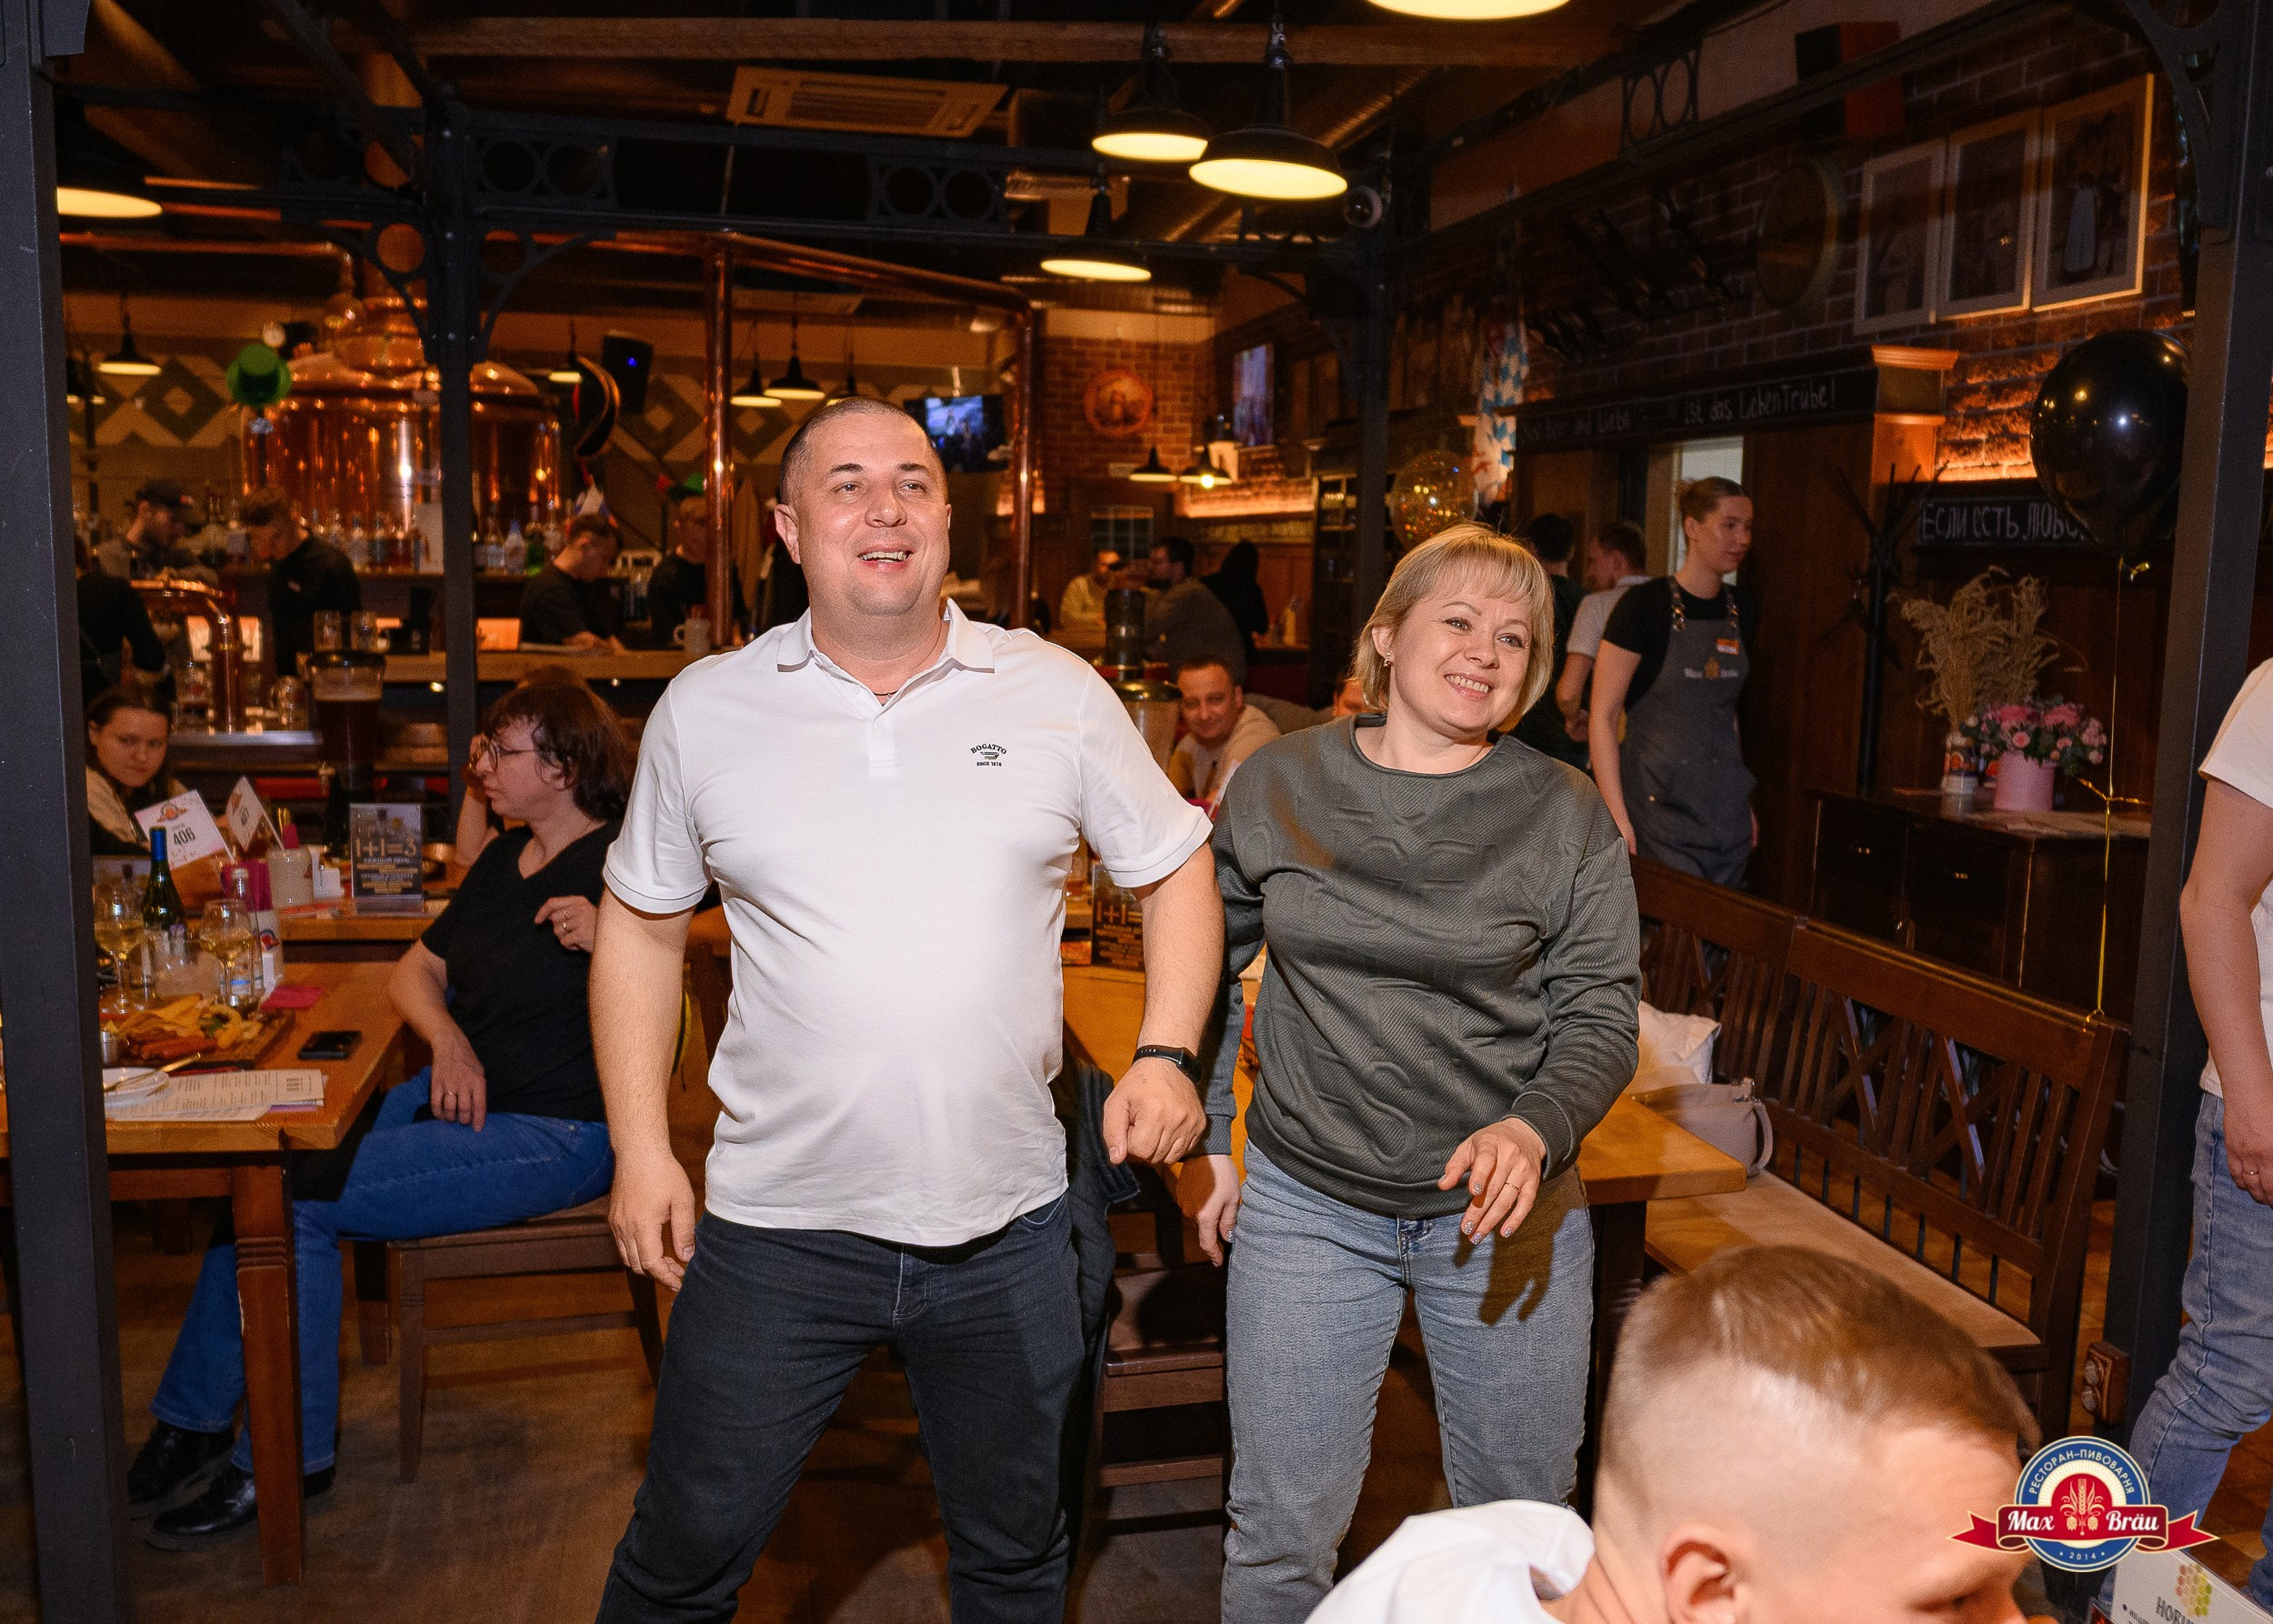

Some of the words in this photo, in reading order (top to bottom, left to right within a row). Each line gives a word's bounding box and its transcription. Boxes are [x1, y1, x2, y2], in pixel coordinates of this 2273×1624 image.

[1709, 393, 1733, 421] das
[970, 743, 1007, 755] BOGATTO
[173, 827, 195, 846] 406
[355, 837, 417, 857] 1+1=3
